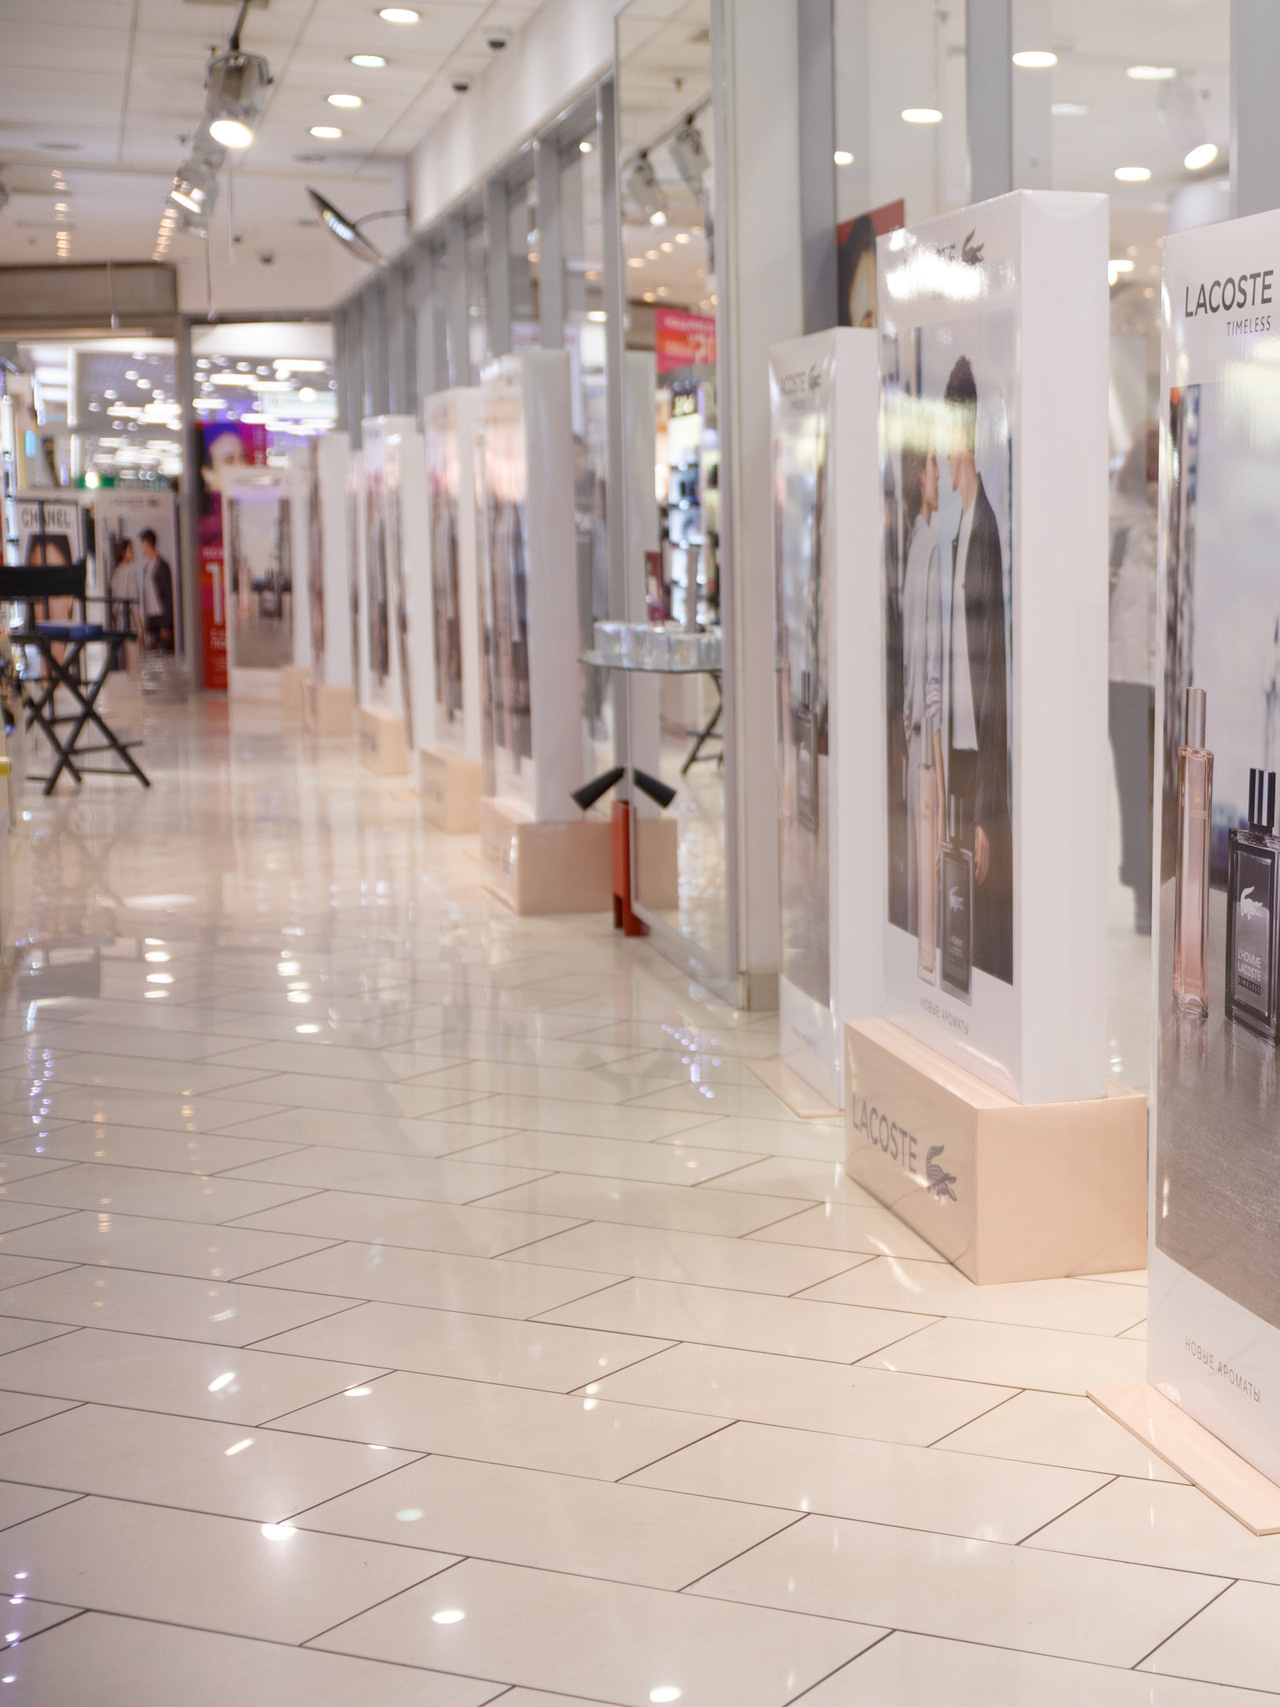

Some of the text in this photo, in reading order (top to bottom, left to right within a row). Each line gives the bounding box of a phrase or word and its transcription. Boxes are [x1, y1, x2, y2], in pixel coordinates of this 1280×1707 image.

[1185, 269, 1274, 318] LACOSTE
[1227, 315, 1271, 337] TIMELESS
[21, 507, 72, 529] CHNEL
[1237, 963, 1262, 982] LACOSTE
[852, 1091, 918, 1174] LACOSTE
[1184, 1337, 1261, 1404] НОВЫЕ АРОМАТЫ
